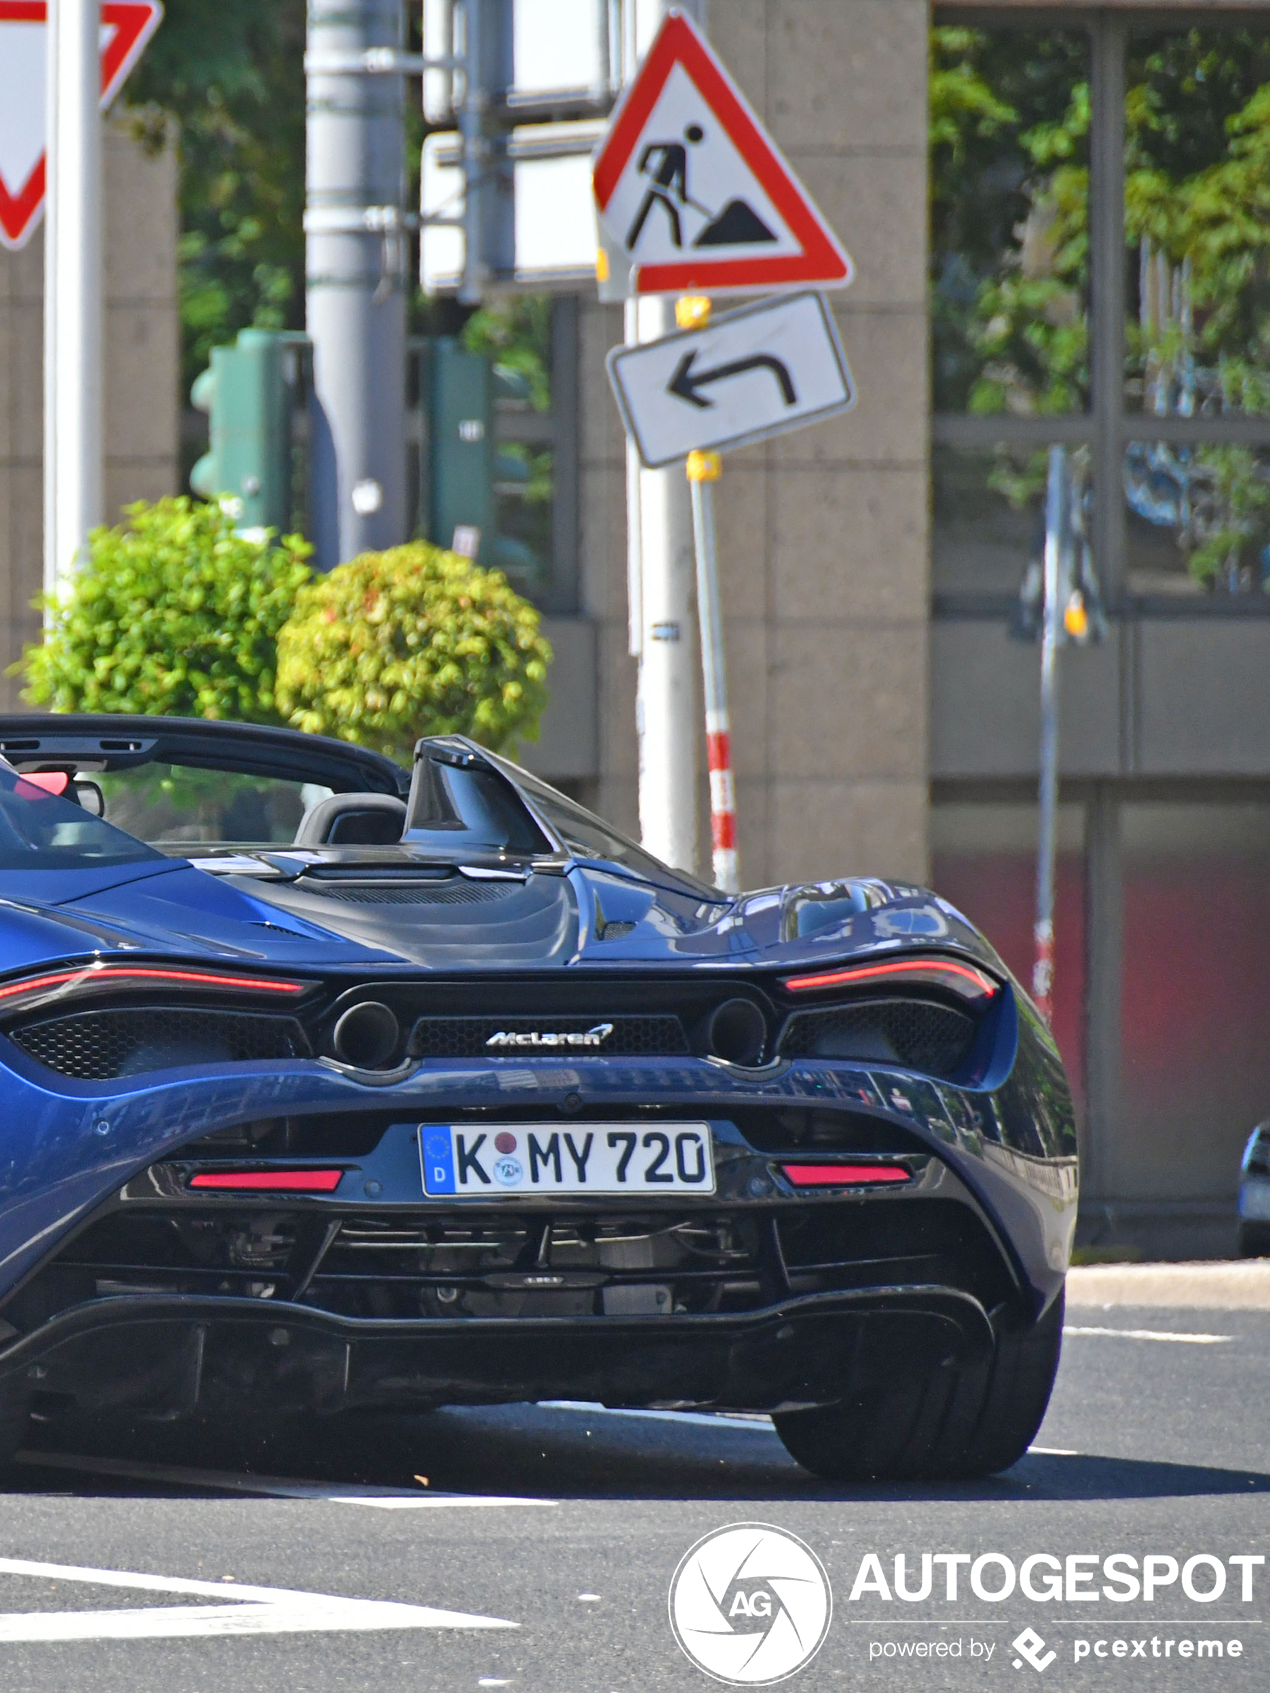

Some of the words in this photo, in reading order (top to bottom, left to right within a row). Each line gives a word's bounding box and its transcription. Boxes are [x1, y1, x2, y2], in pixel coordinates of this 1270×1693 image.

[486, 1031, 601, 1046] McLaren
[456, 1133, 491, 1184] K
[527, 1132, 594, 1184] MY
[607, 1132, 706, 1184] 720
[434, 1166, 446, 1183] D
